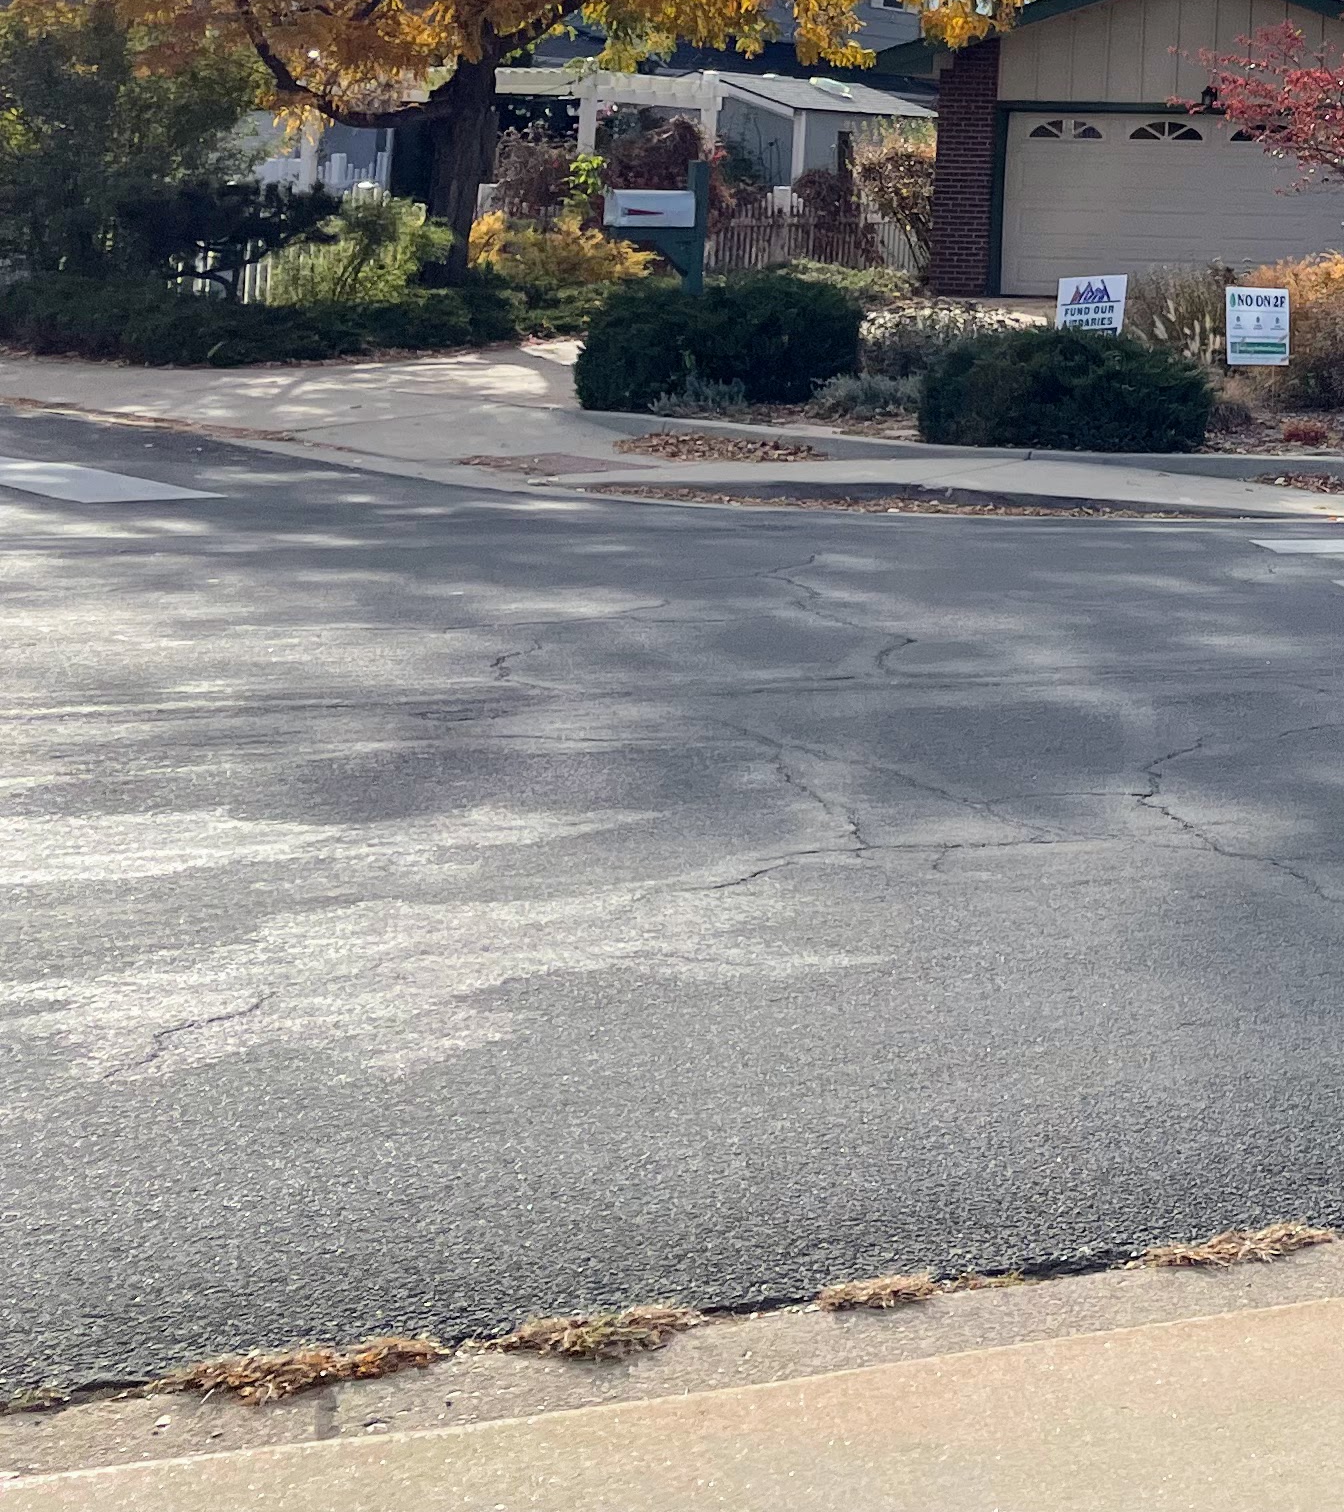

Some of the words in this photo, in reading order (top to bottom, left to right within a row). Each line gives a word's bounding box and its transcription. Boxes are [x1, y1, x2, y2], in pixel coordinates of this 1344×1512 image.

[1237, 294, 1253, 307] NO
[1256, 295, 1271, 307] ON
[1064, 306, 1090, 317] FUND
[1093, 305, 1115, 315] OUR
